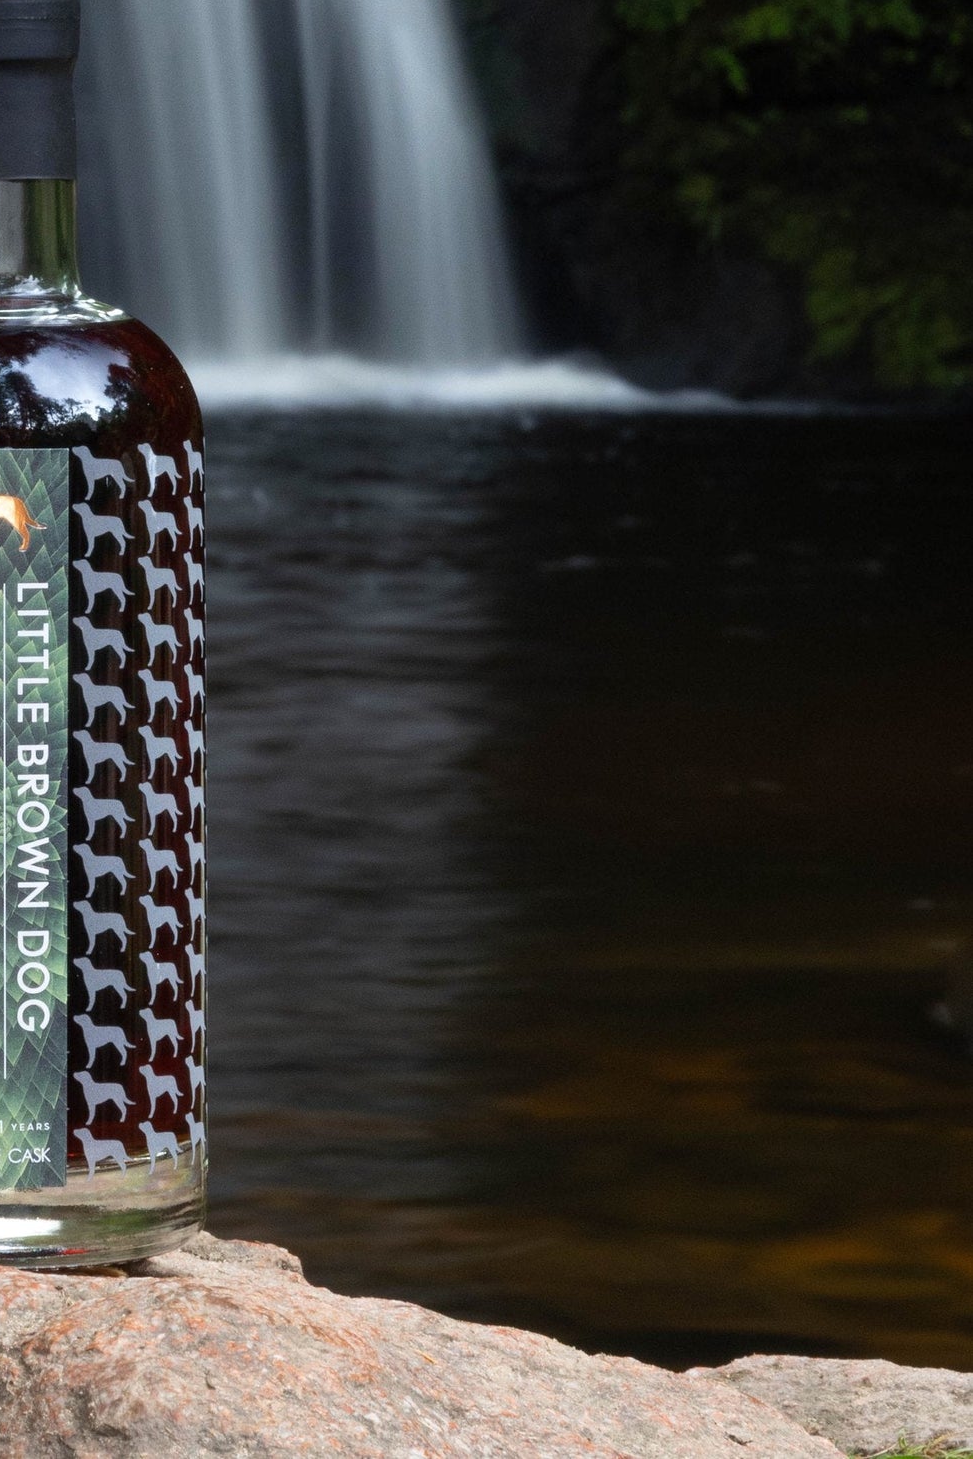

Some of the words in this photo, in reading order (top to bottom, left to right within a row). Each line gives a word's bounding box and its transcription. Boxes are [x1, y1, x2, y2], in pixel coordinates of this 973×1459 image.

[17, 582, 49, 723] LITTLE
[16, 744, 50, 908] BROWN
[16, 929, 50, 1031] DOG
[8, 1147, 51, 1164] CASK
[11, 1122, 51, 1132] YEARS
